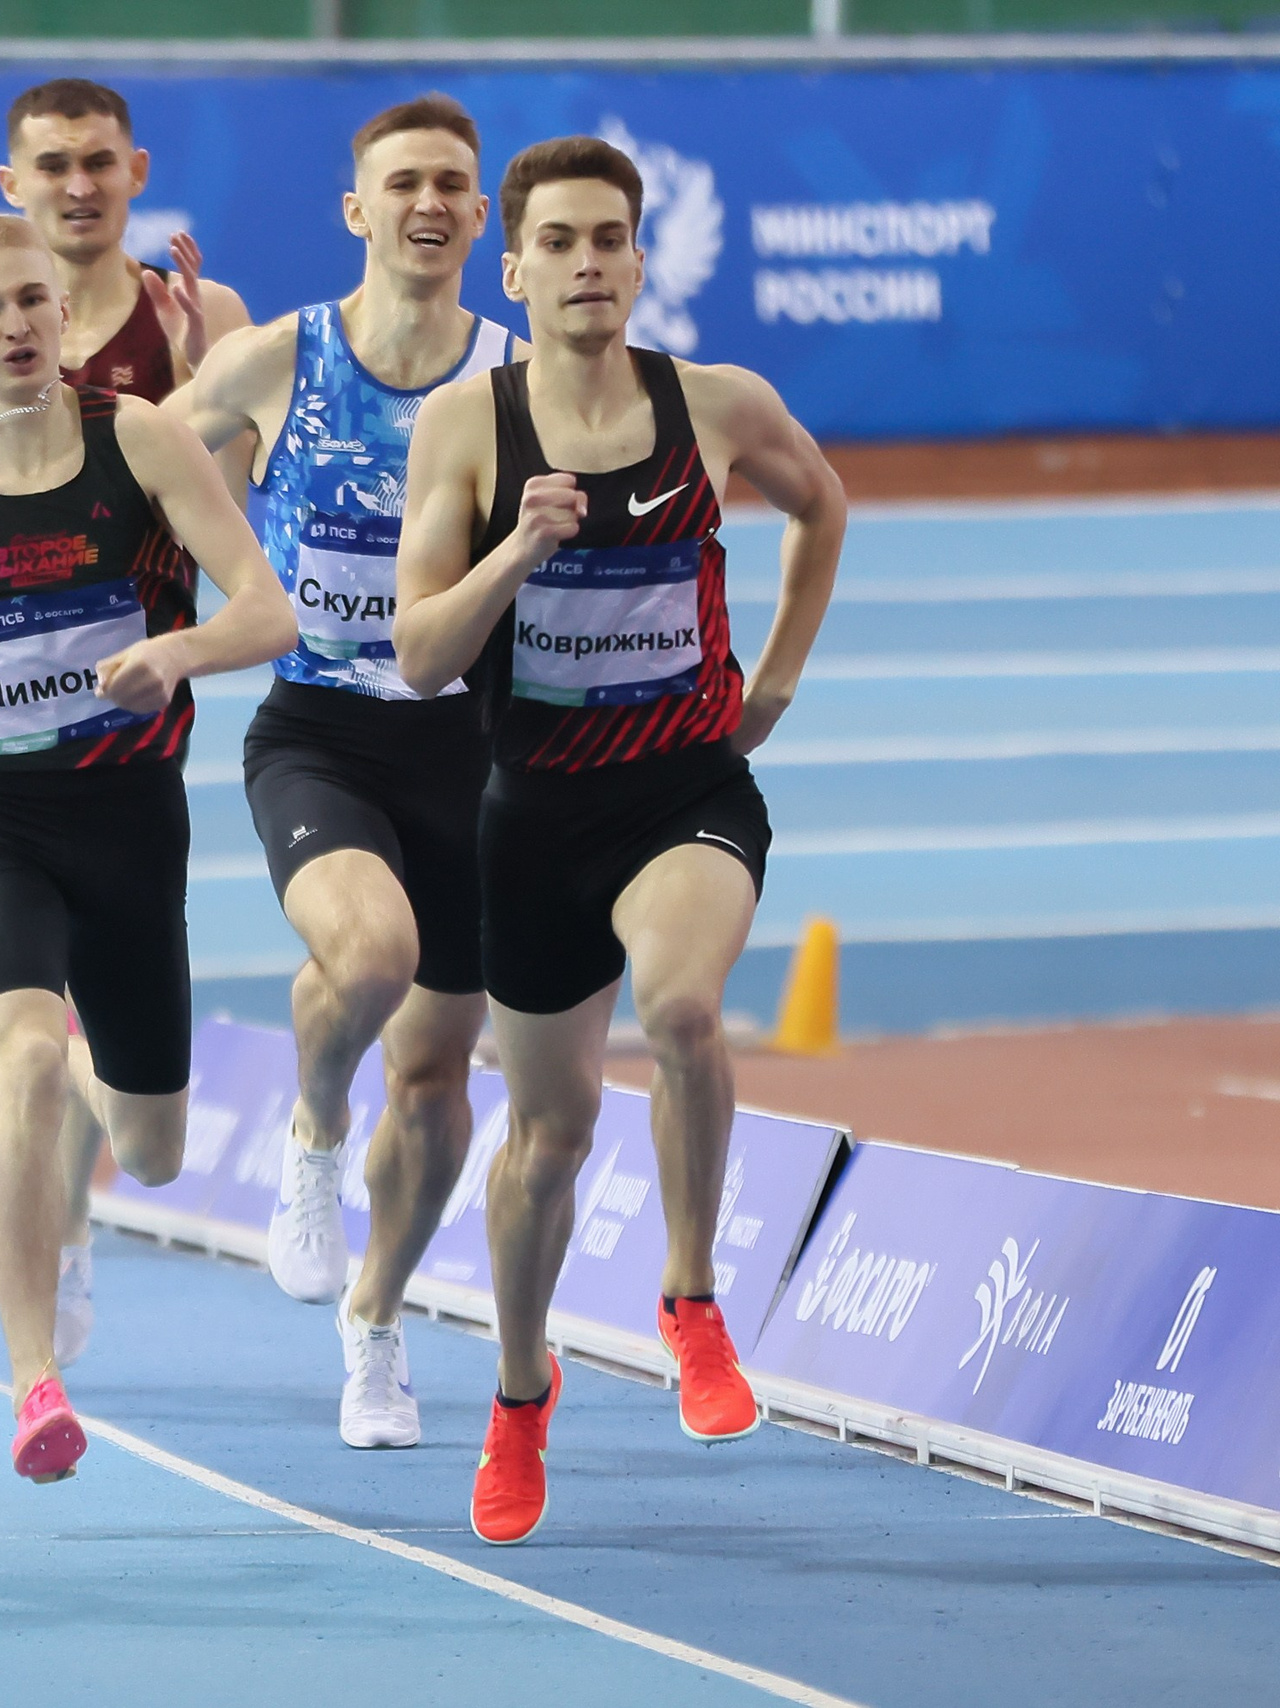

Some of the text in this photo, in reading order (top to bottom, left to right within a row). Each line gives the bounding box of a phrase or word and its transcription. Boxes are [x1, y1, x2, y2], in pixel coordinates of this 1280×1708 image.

[754, 269, 941, 323] РОССИИ
[329, 527, 357, 540] ПСБ
[551, 562, 583, 575] ПСБ
[518, 621, 696, 661] Коврижных
[821, 1247, 930, 1342] ФОСАГРО
[1001, 1287, 1070, 1356] ВФЛА
[1096, 1379, 1195, 1445] ЗАРУБЕЖНЕФТЬ
